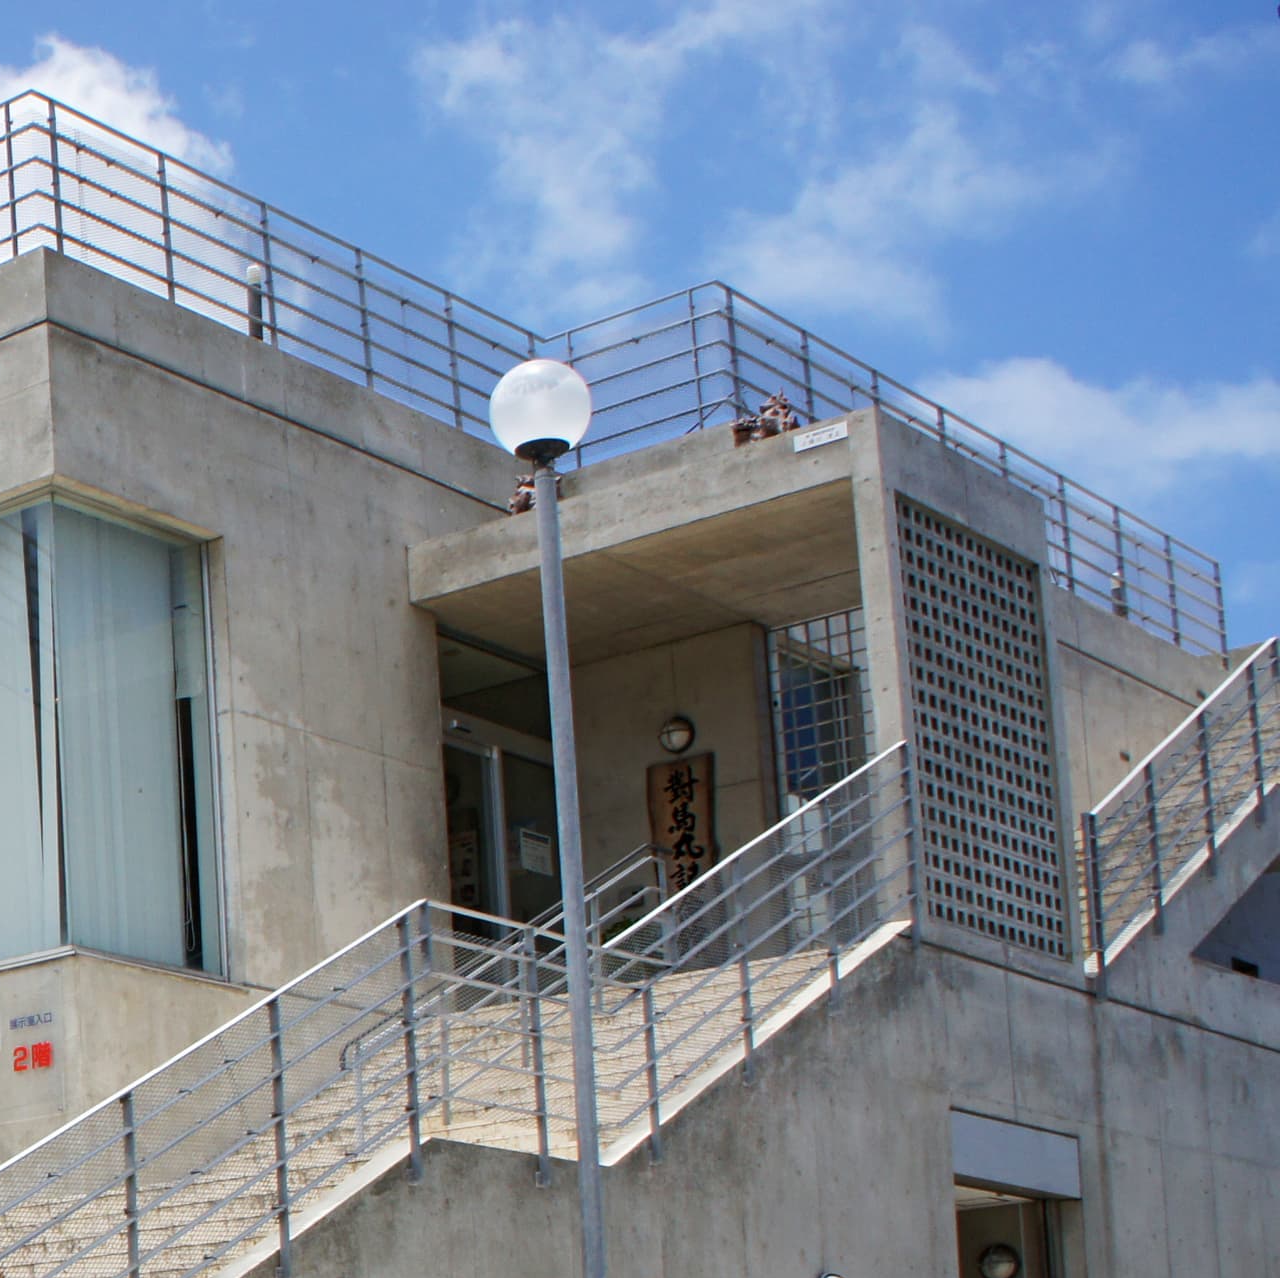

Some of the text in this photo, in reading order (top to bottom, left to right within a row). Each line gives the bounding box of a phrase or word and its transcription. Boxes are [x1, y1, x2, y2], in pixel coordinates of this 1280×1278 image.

[664, 757, 706, 930] 對馬丸記
[13, 1041, 54, 1072] 2階
